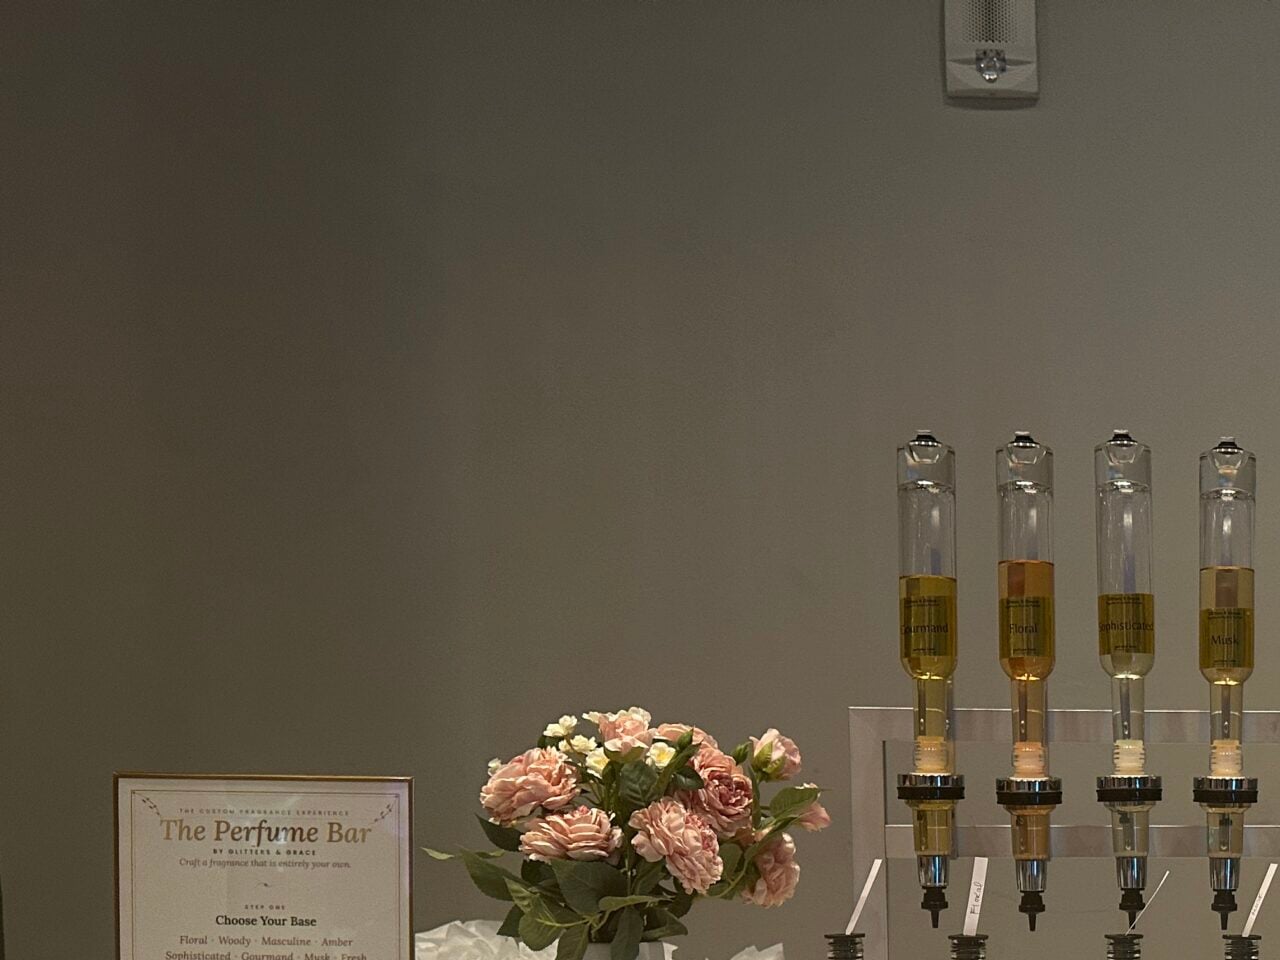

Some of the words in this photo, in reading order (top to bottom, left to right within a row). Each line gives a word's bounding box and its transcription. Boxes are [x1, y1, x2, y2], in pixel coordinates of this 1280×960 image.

[1009, 623, 1038, 634] Floral
[1211, 634, 1239, 645] Musk
[160, 819, 206, 841] The
[213, 819, 319, 847] Perfume
[327, 822, 372, 843] Bar
[969, 881, 984, 915] Floral
[215, 915, 258, 926] Choose
[260, 916, 288, 926] Your
[290, 916, 317, 926] Base
[180, 935, 207, 945] Floral
[218, 935, 251, 948] Woody
[261, 936, 311, 946] Masculine
[321, 937, 353, 947] Amber
[241, 951, 293, 960] Gourmand
